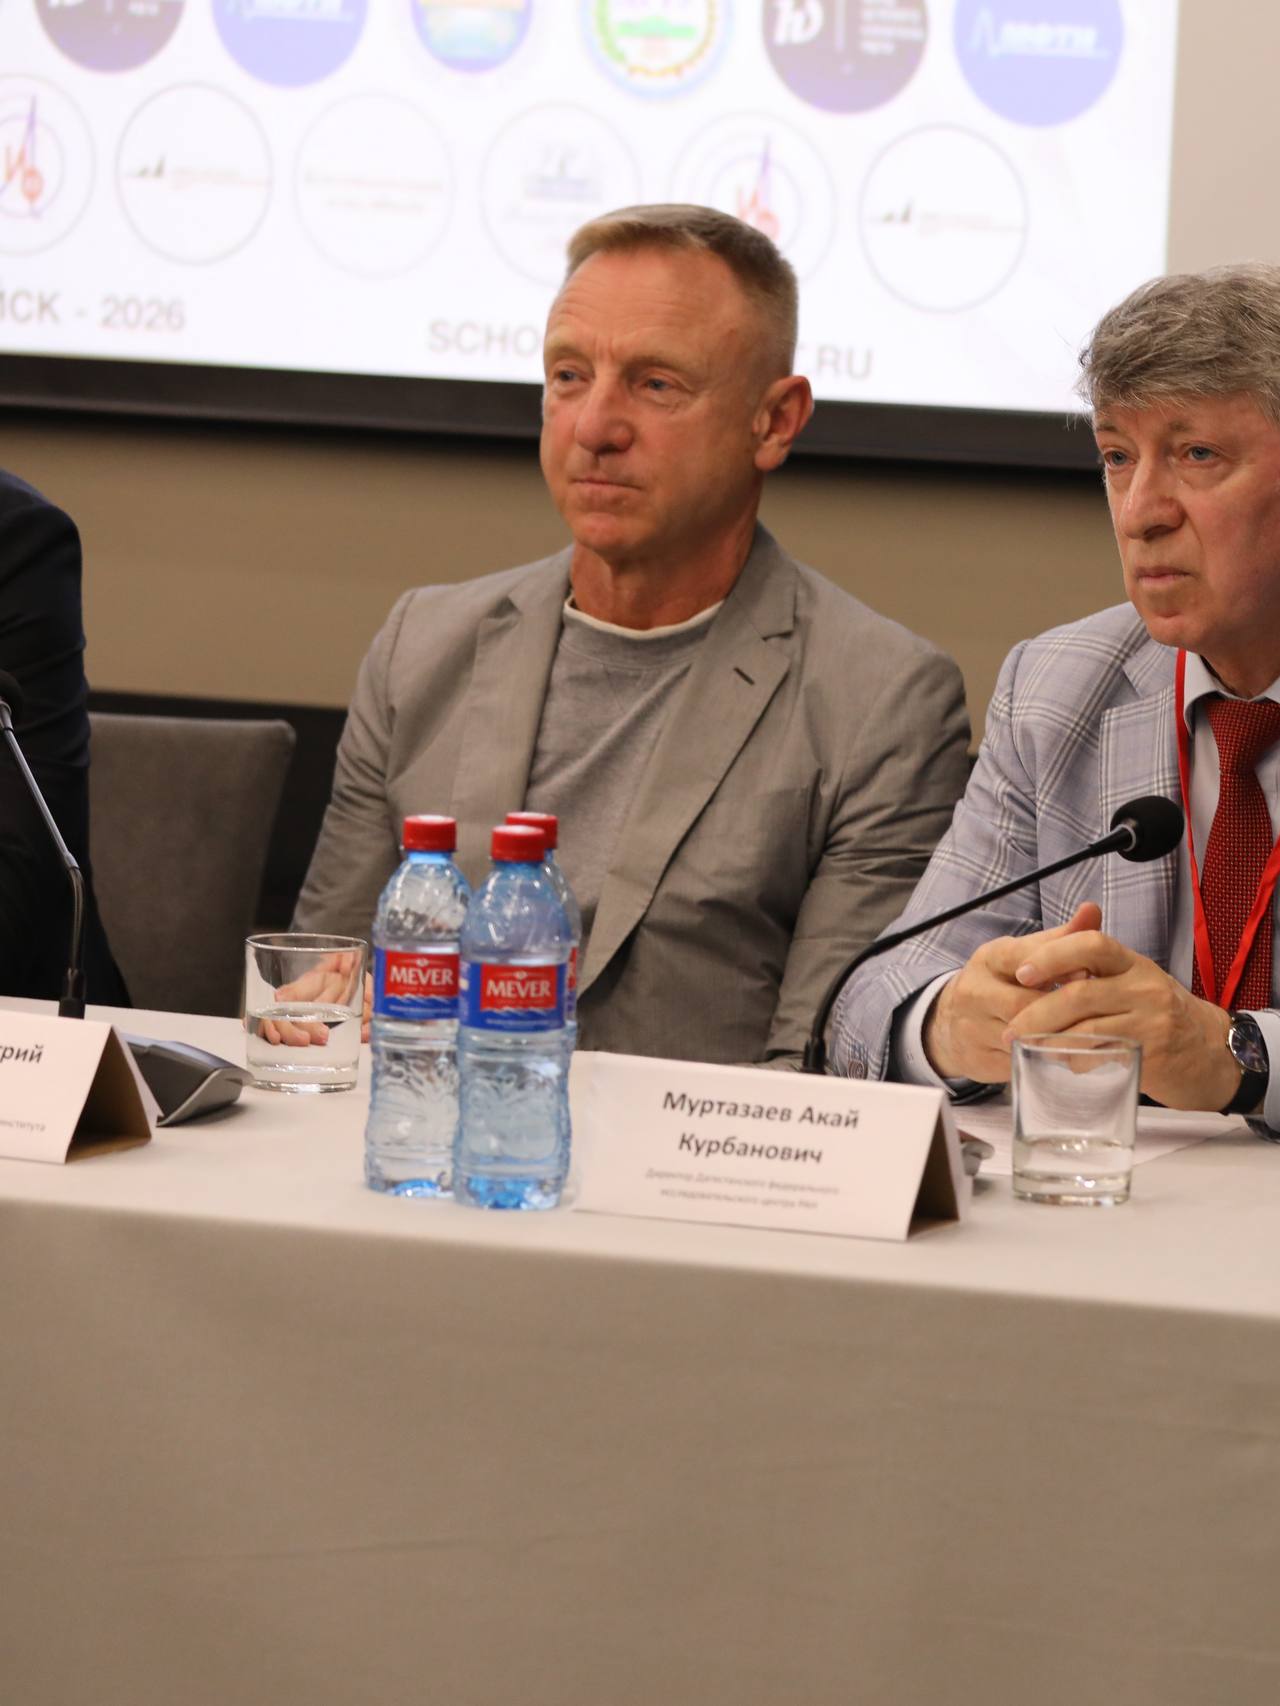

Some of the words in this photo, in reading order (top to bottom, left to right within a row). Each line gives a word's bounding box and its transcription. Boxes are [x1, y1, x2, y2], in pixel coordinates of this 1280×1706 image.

[101, 291, 187, 332] 2026
[388, 964, 454, 987] MEVER
[485, 979, 551, 999] MEVER
[0, 1044, 44, 1063] рий
[662, 1091, 792, 1124] Муртазаев
[798, 1106, 859, 1129] Акай
[678, 1133, 823, 1164] Курбанович
